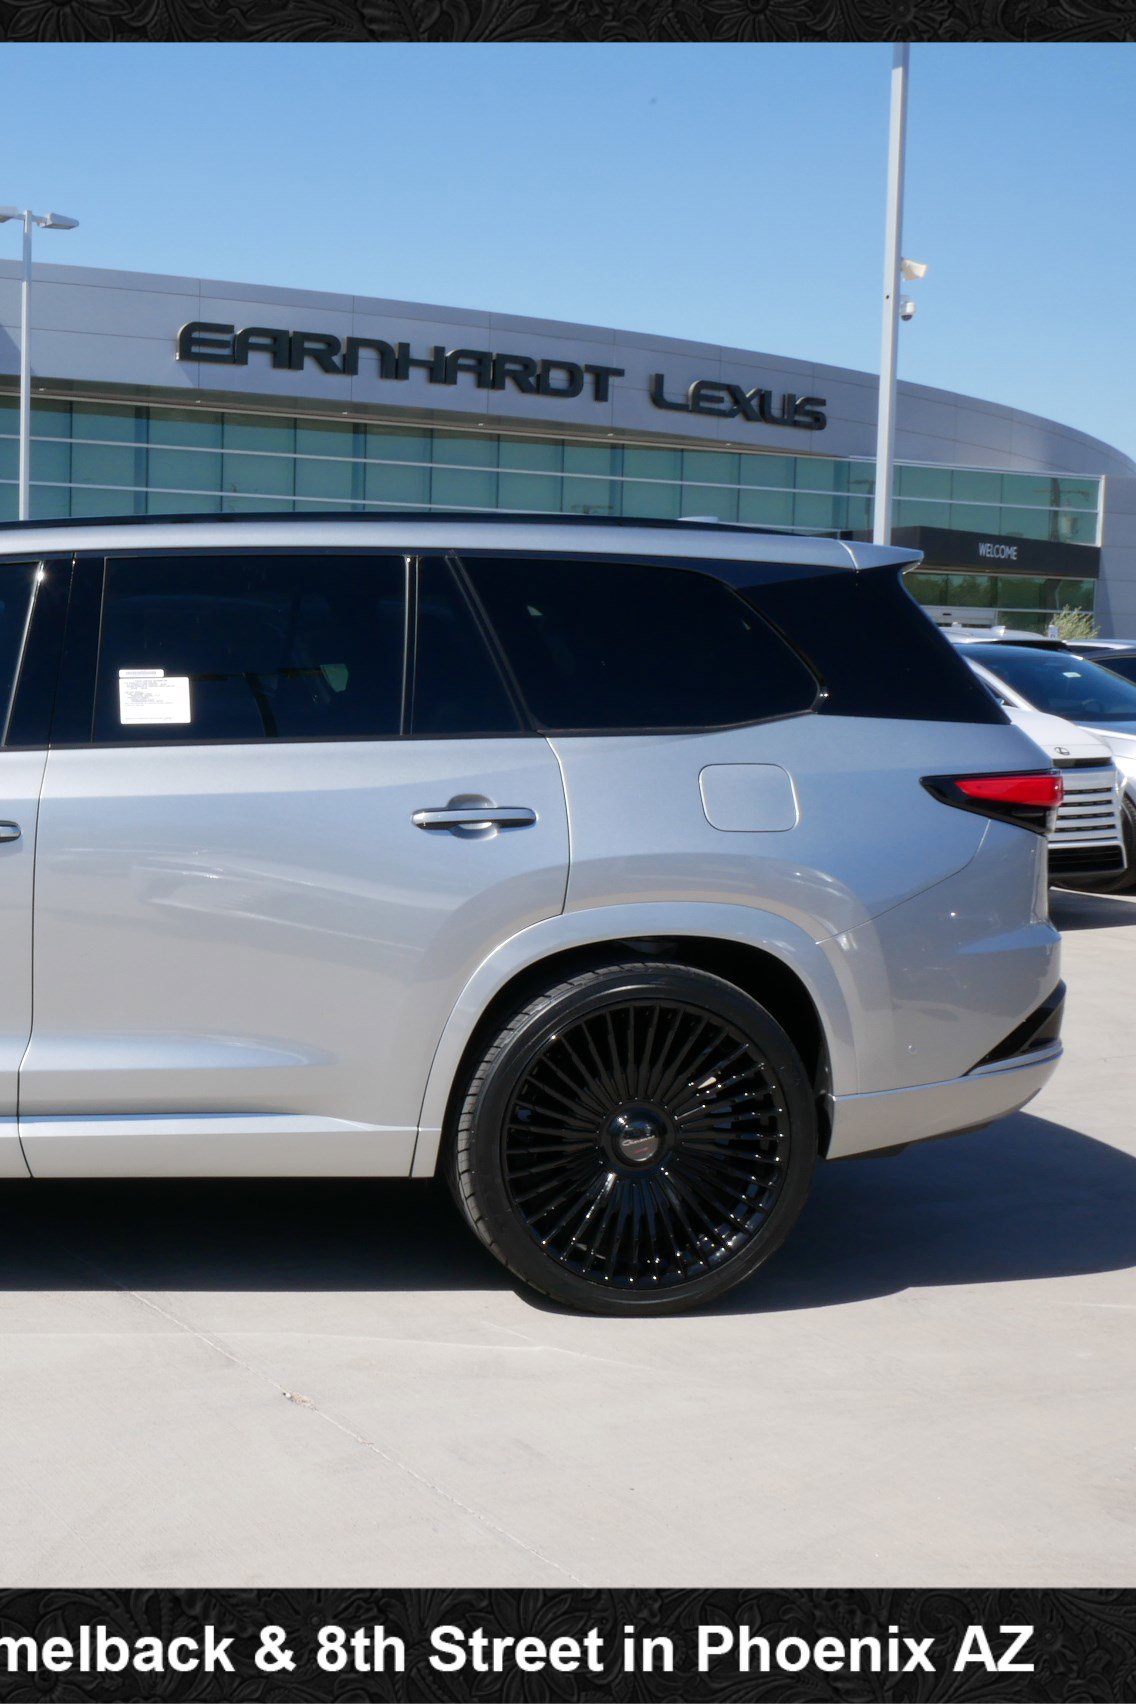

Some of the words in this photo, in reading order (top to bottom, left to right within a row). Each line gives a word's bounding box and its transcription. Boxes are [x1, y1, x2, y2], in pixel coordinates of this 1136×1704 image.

[175, 320, 625, 402] EARNHARDT
[649, 372, 828, 432] LEXUS
[978, 542, 1018, 560] WELCOME
